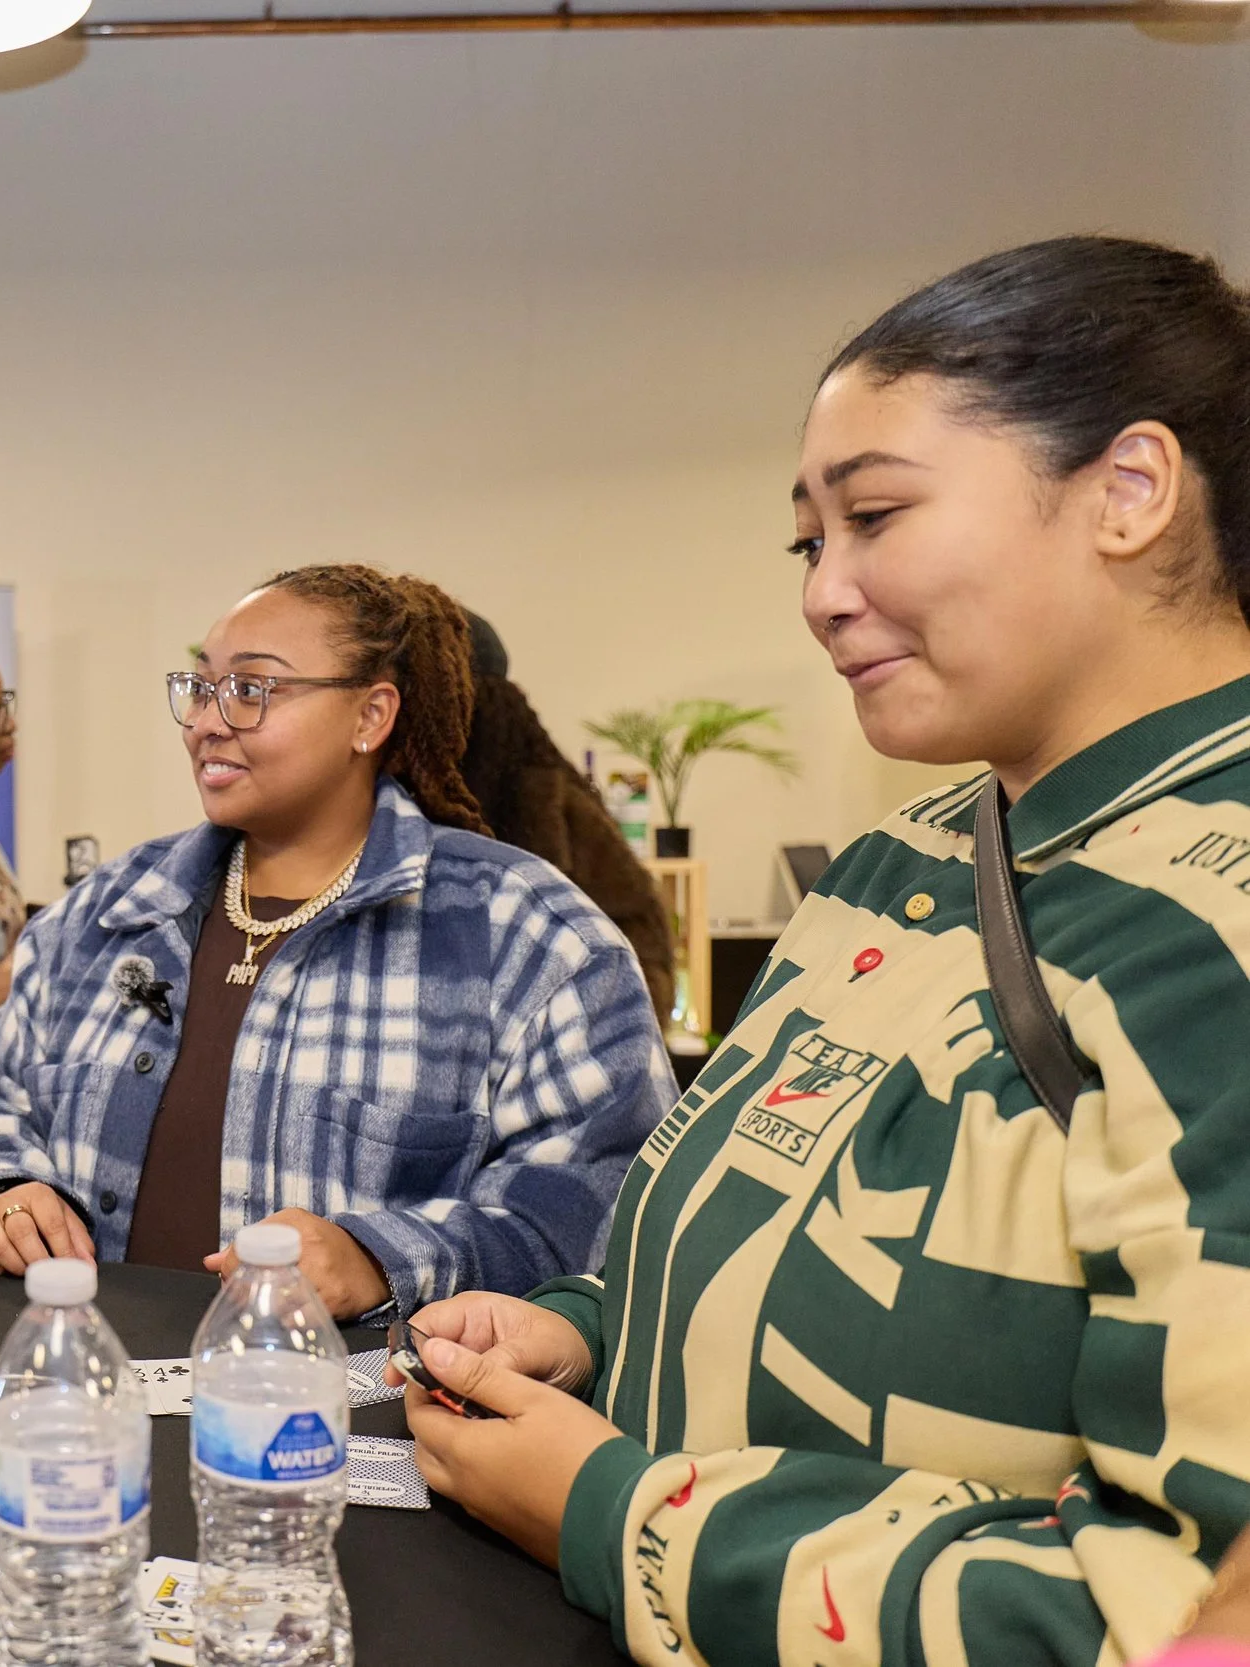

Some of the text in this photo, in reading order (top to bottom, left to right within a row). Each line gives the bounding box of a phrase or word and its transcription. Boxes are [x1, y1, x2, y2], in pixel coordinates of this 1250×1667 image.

[741, 1112, 807, 1153] SPORTS
[153, 1367, 167, 1377] 4
[267, 1444, 335, 1471] WATER
